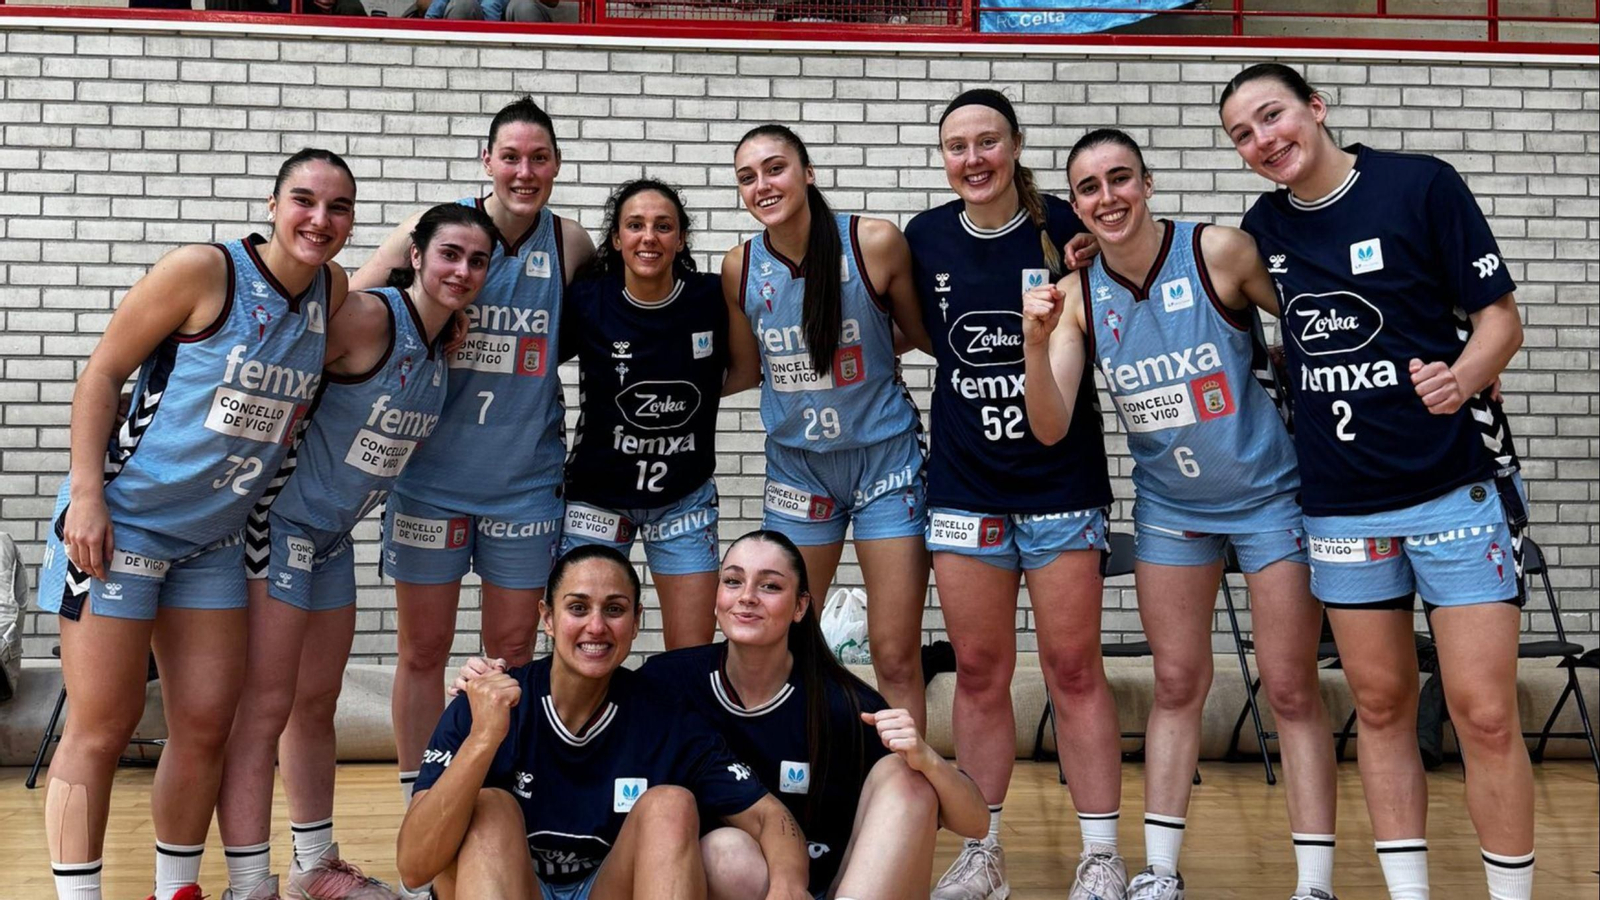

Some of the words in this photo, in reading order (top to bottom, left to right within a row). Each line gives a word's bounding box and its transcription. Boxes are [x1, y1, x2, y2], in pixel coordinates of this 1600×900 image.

[465, 304, 549, 334] emxa
[1296, 308, 1359, 341] Zorka
[757, 318, 861, 352] fema
[963, 324, 1021, 353] Zorka
[461, 339, 510, 353] ONCELLO
[457, 351, 473, 361] DE
[475, 352, 502, 364] VIGO
[770, 362, 815, 372] ONCELL
[1101, 342, 1223, 392] femxa
[774, 375, 787, 384] DE
[790, 373, 818, 384] VIGO
[951, 368, 1026, 399] femx
[220, 396, 284, 420] CONCELLO
[477, 390, 494, 425] 7
[634, 392, 686, 418] Zorka
[1123, 393, 1183, 412] CONCELLO
[223, 412, 243, 428] DE
[245, 418, 274, 433] VIGO
[366, 394, 439, 438] femxa
[803, 407, 841, 440] 29
[981, 405, 1025, 441] 52
[1133, 413, 1149, 425] DE
[1150, 407, 1179, 422] VIGO
[1331, 400, 1356, 442] 2
[360, 437, 408, 457] CONCELLO
[613, 425, 696, 456] femxa
[361, 452, 380, 466] DE
[382, 458, 398, 468] VIGO
[1173, 446, 1200, 478] 6
[212, 454, 263, 496] 32
[636, 460, 668, 492] 12
[766, 484, 806, 503] CONCELLO
[853, 466, 912, 506] ecalvi
[768, 494, 777, 504] DE
[777, 498, 799, 510] VIGO
[396, 519, 443, 534] CONCELLO
[478, 516, 556, 538] Recalvi
[568, 510, 615, 526] CONCELLO
[572, 520, 583, 528] DE
[586, 522, 608, 534] VIGO
[642, 508, 709, 542] Recalvi
[934, 519, 974, 532] CONCELLO
[399, 530, 410, 538] DE
[413, 533, 436, 542] VIGO
[935, 530, 943, 538] DE
[944, 530, 968, 540] VIGO
[298, 554, 307, 563] DE
[1314, 543, 1323, 553] DE
[1325, 545, 1352, 554] VIGO
[125, 556, 141, 567] DE
[144, 558, 165, 570] VIGO
